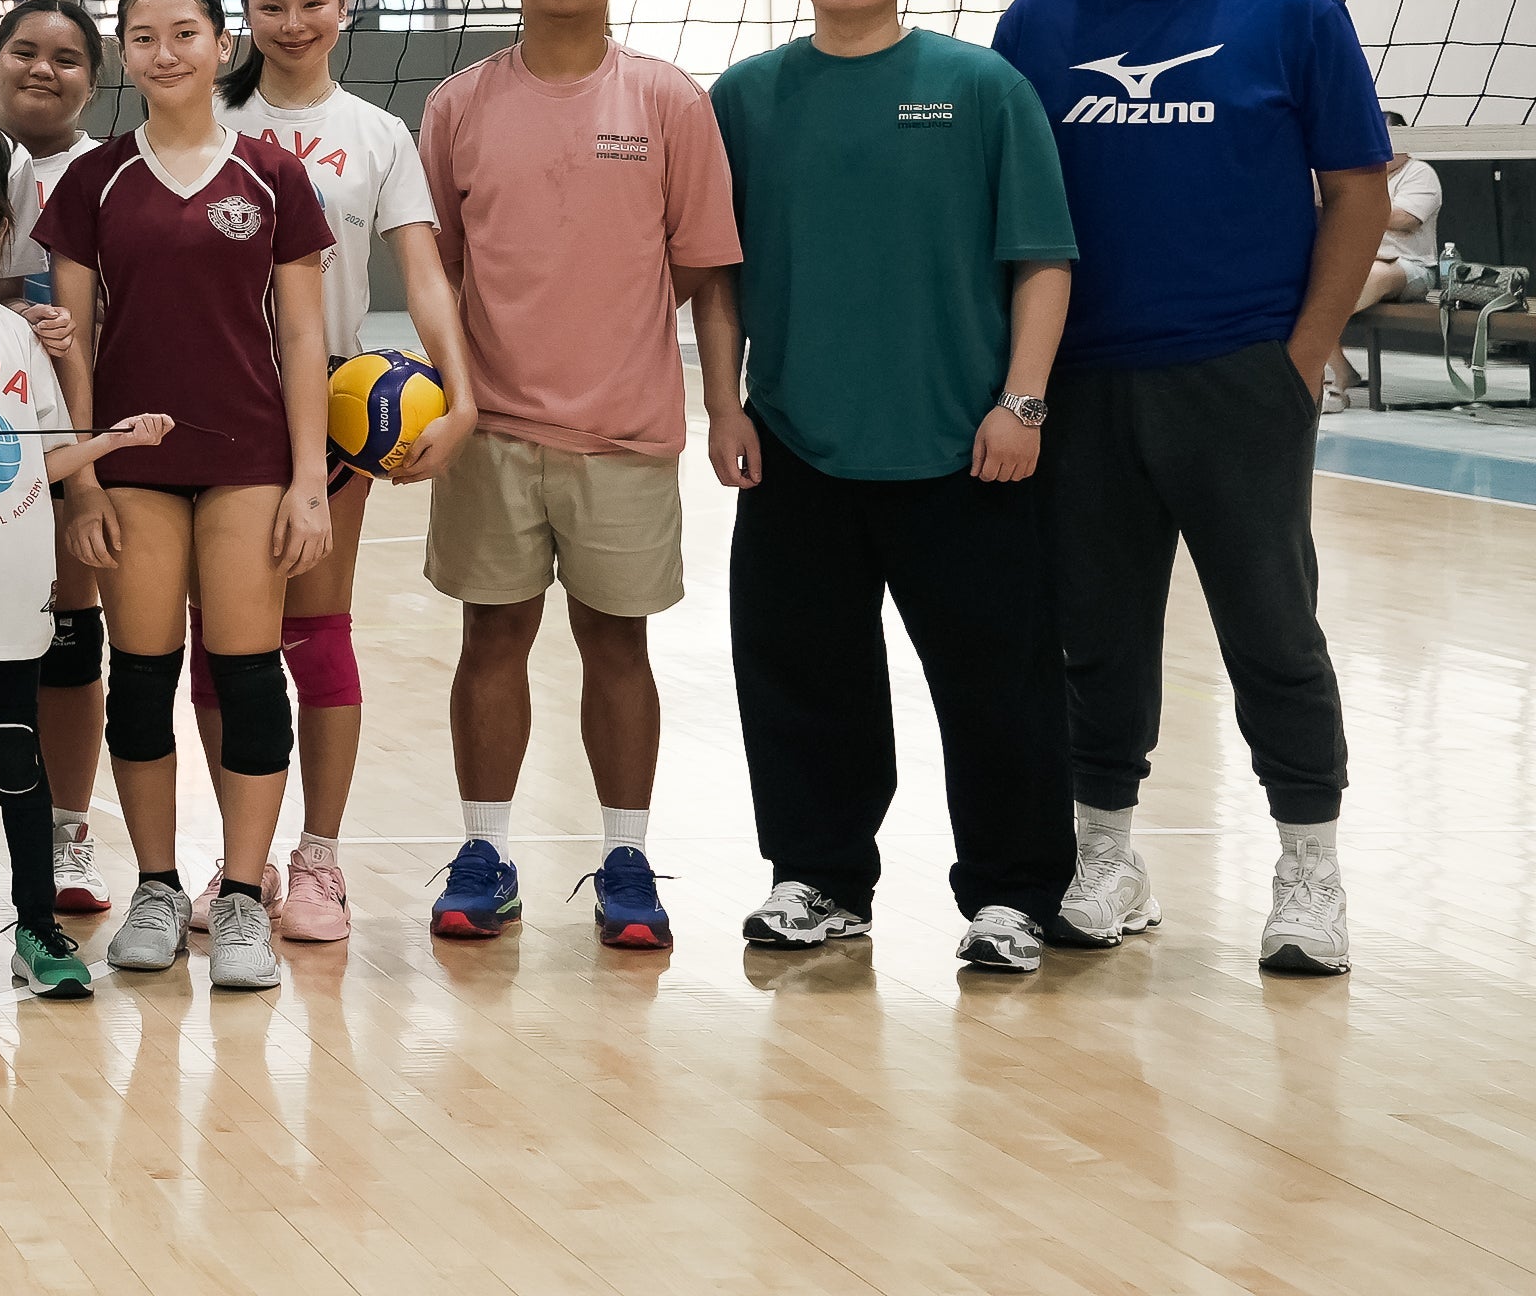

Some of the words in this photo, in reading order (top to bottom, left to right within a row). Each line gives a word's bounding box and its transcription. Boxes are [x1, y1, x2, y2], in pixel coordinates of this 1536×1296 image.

[898, 103, 953, 111] MIZUNO
[898, 112, 953, 120] MIZUNO
[597, 134, 649, 143] MIZUNO
[260, 129, 347, 177] AVA
[597, 143, 648, 153] MIZUNO
[344, 213, 366, 228] 2026
[380, 396, 389, 432] V300W
[382, 440, 412, 468] KAVA
[13, 477, 43, 519] ACADEMY
